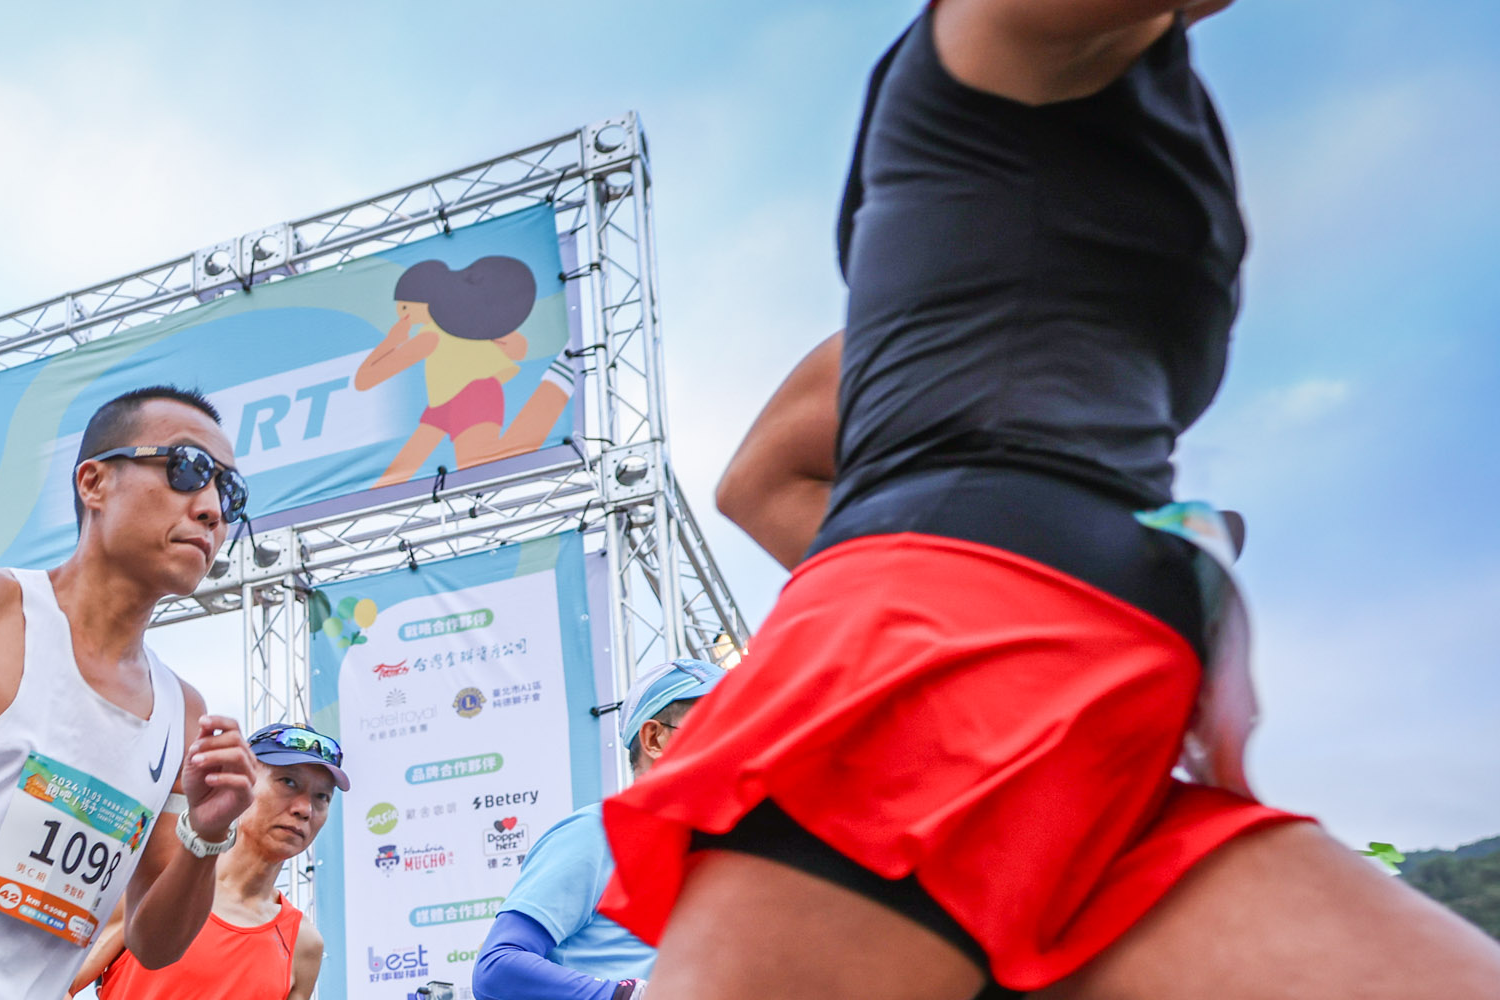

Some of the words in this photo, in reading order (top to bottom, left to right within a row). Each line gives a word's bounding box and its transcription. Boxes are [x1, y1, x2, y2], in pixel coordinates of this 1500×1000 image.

[484, 790, 539, 809] Betery
[487, 829, 525, 844] Doppel
[29, 819, 122, 892] 1098
[404, 853, 446, 872] MUCHO
[0, 889, 20, 904] 42
[25, 894, 42, 908] km
[368, 944, 429, 972] best
